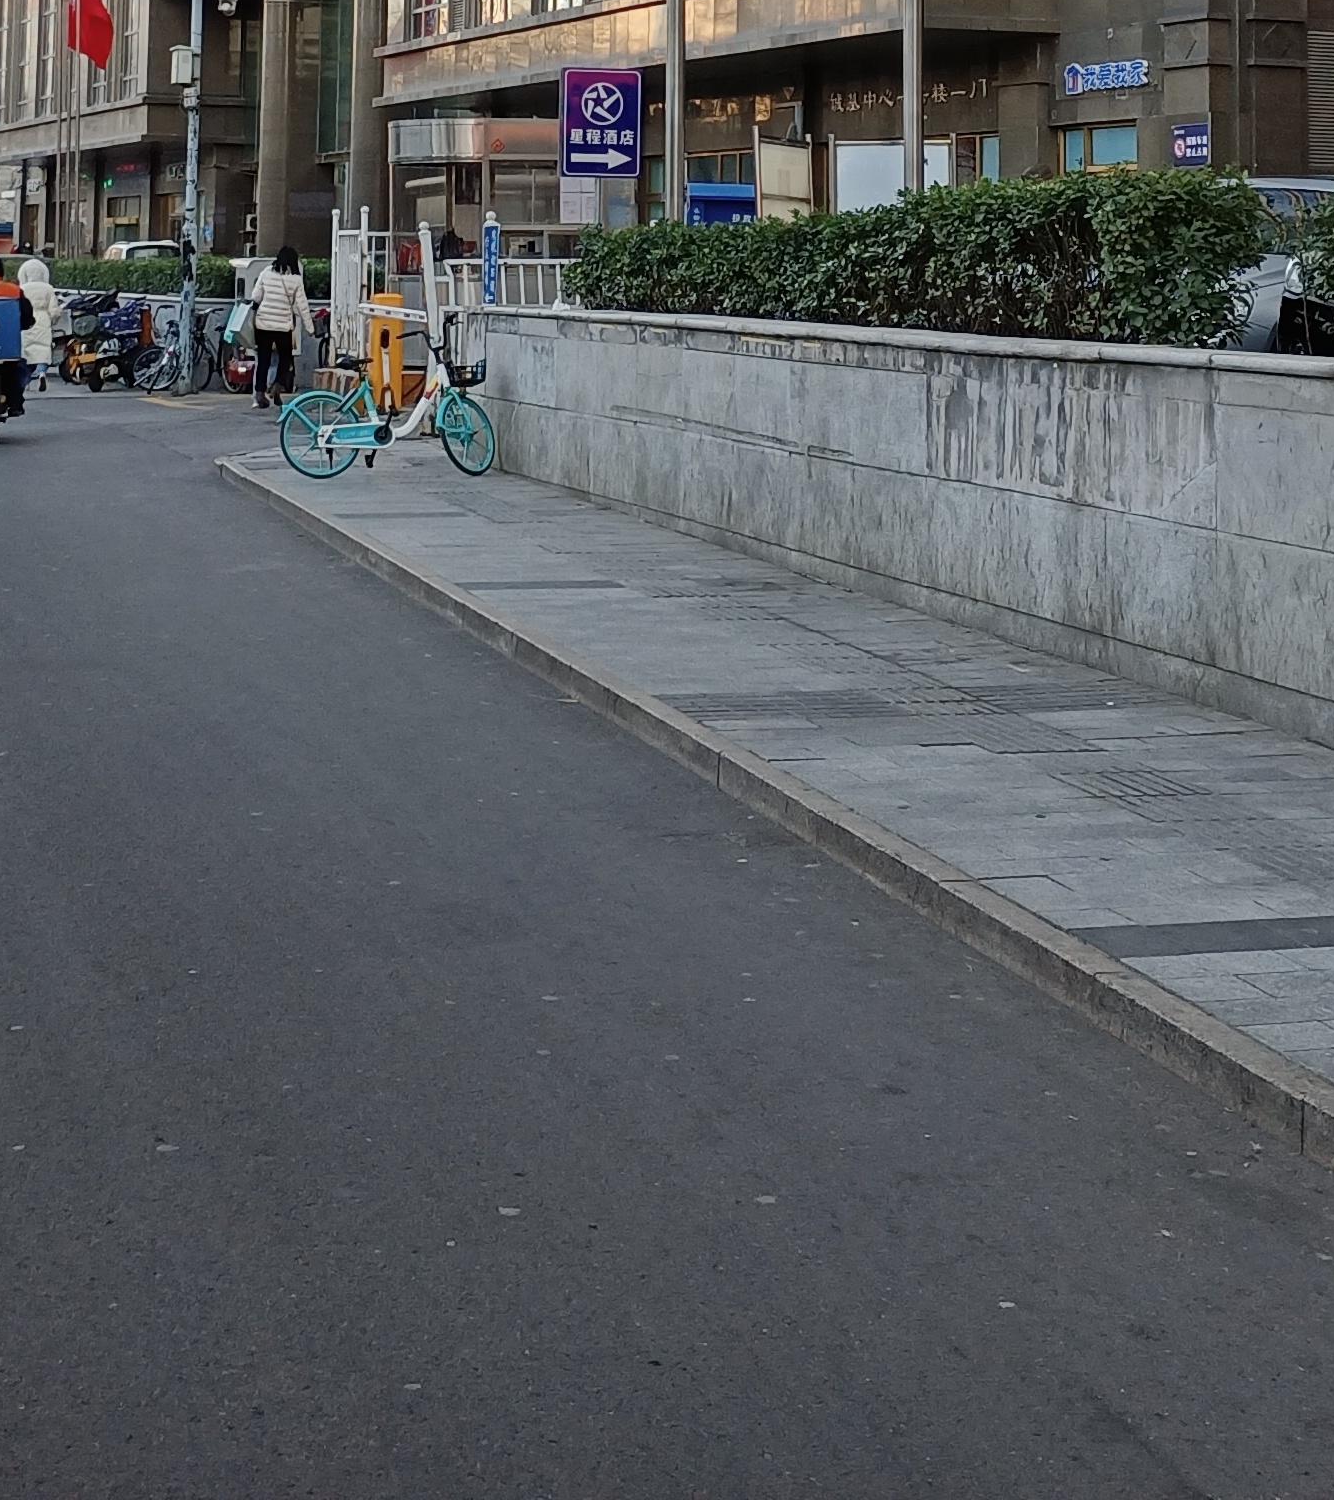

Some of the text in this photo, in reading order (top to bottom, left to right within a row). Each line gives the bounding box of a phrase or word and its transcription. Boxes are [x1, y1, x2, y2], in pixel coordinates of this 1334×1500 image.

[1082, 60, 1147, 91] 我爱我家
[569, 128, 635, 146] 星程酒店
